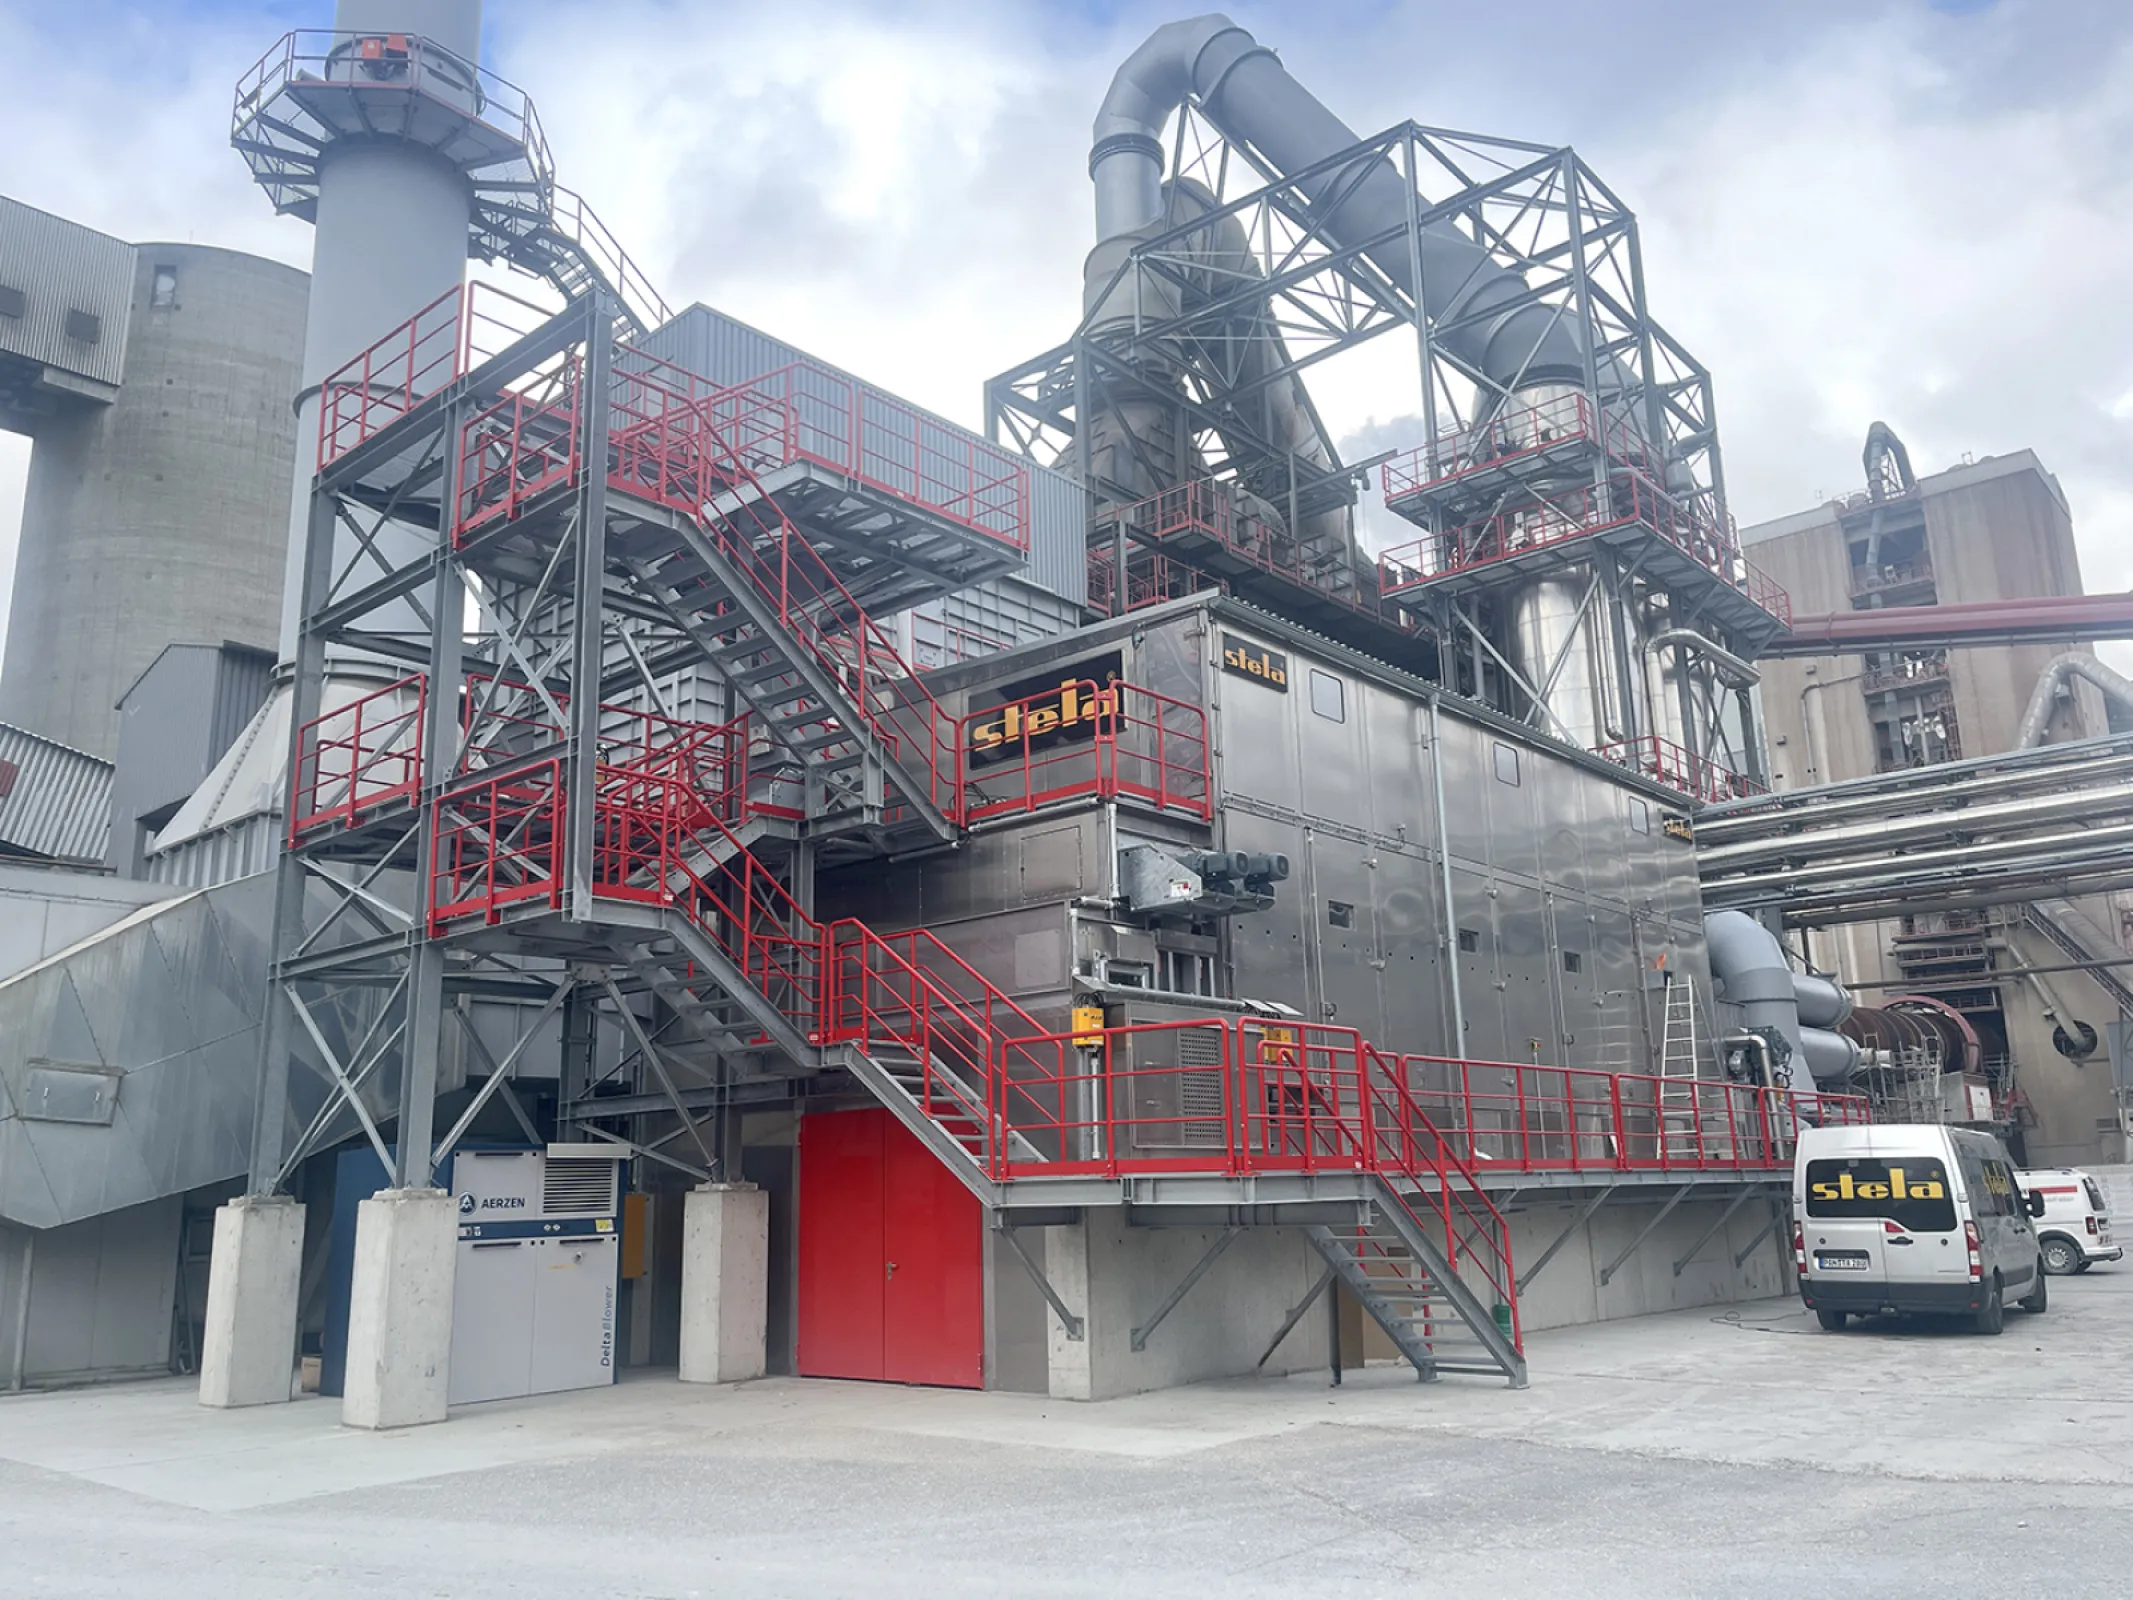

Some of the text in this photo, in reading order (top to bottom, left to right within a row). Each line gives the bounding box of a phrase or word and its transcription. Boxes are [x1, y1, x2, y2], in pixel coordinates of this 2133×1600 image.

[1224, 647, 1286, 685] stela
[973, 677, 1119, 752] stela
[1811, 1168, 1944, 1200] stela
[481, 1197, 525, 1209] AERZEN
